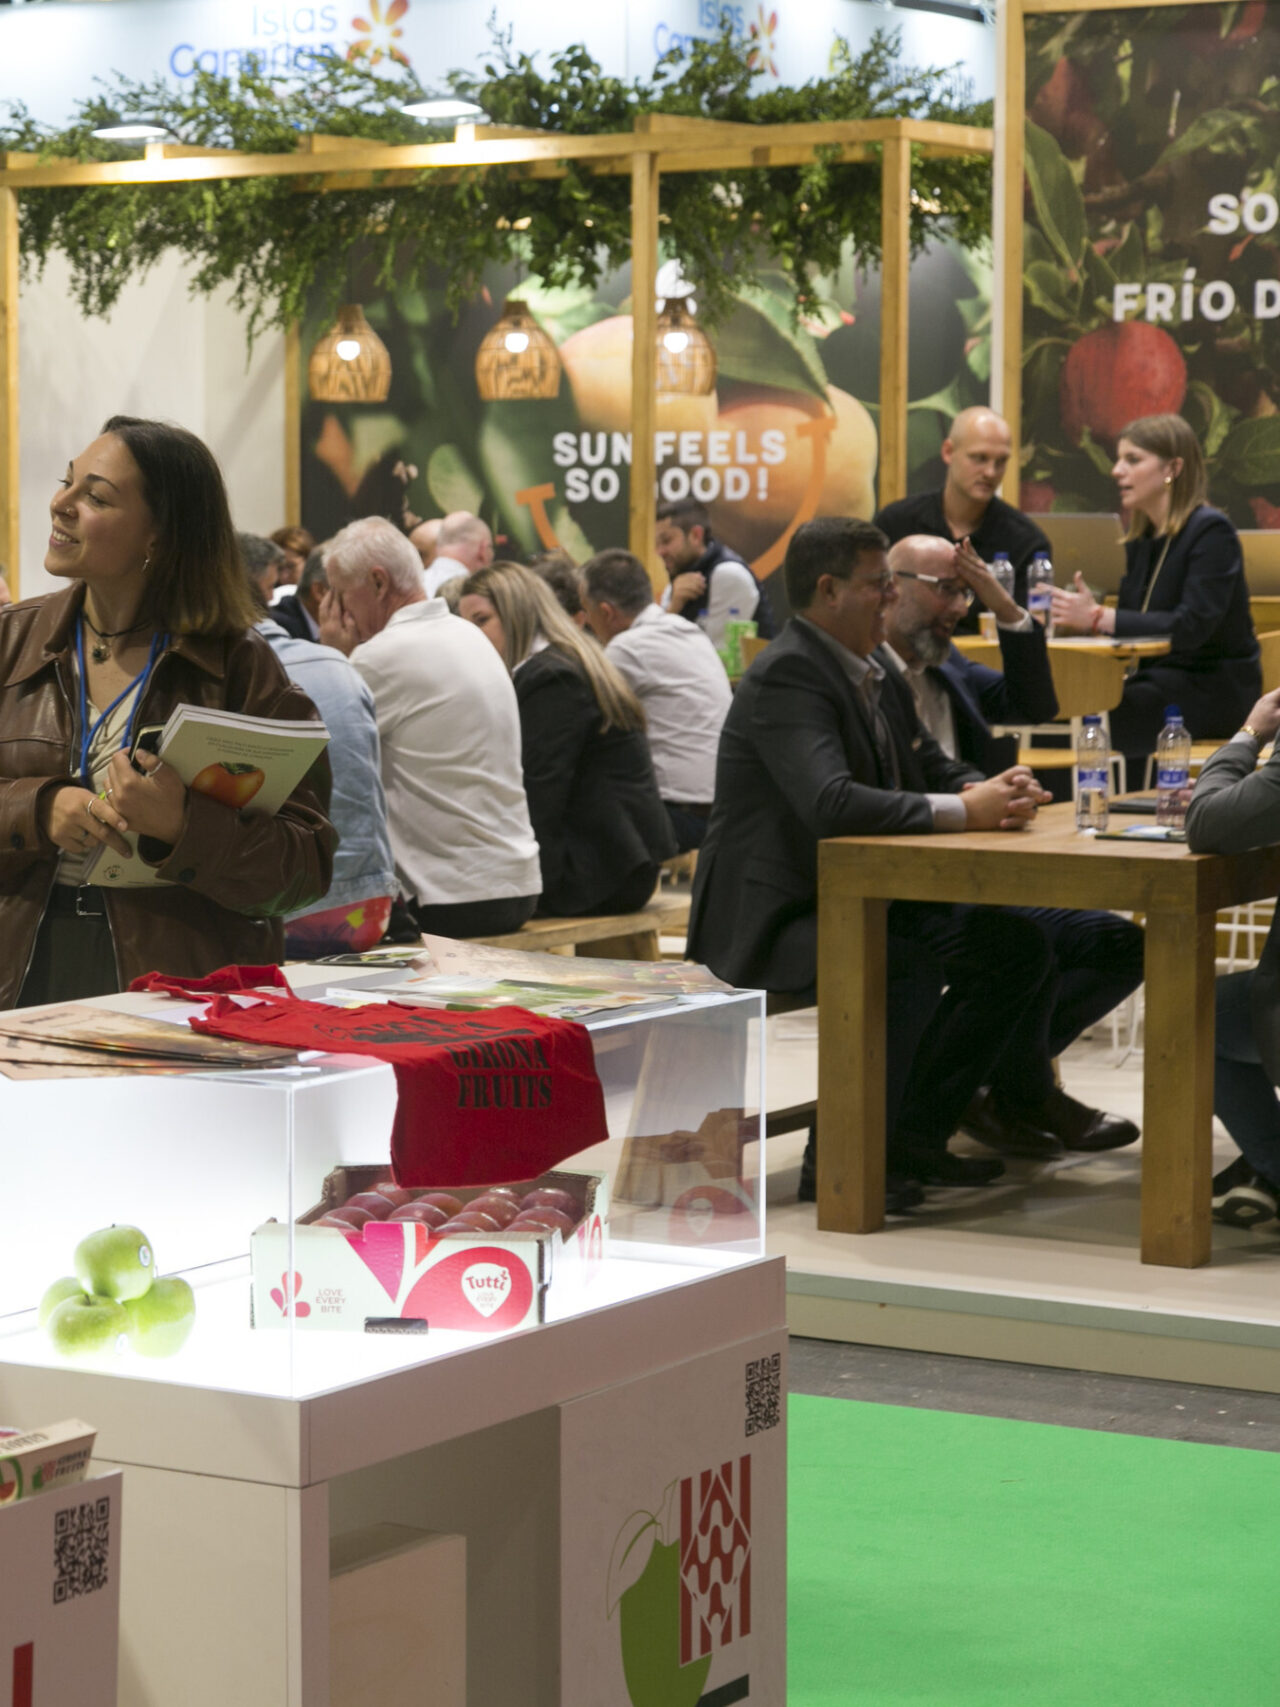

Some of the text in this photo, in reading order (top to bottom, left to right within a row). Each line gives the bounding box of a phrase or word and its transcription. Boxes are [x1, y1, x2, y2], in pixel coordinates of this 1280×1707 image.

[1208, 193, 1279, 235] SO
[1113, 267, 1236, 322] FRÍO
[553, 430, 786, 466] SUN FEELS
[565, 467, 768, 502] SO OOD!
[446, 1038, 551, 1070] GIRONA
[457, 1075, 553, 1109] FRUITS
[318, 1288, 344, 1297] LOVE
[465, 1270, 508, 1291] Tutti
[316, 1297, 346, 1305] EVERY
[320, 1305, 342, 1314] BITE
